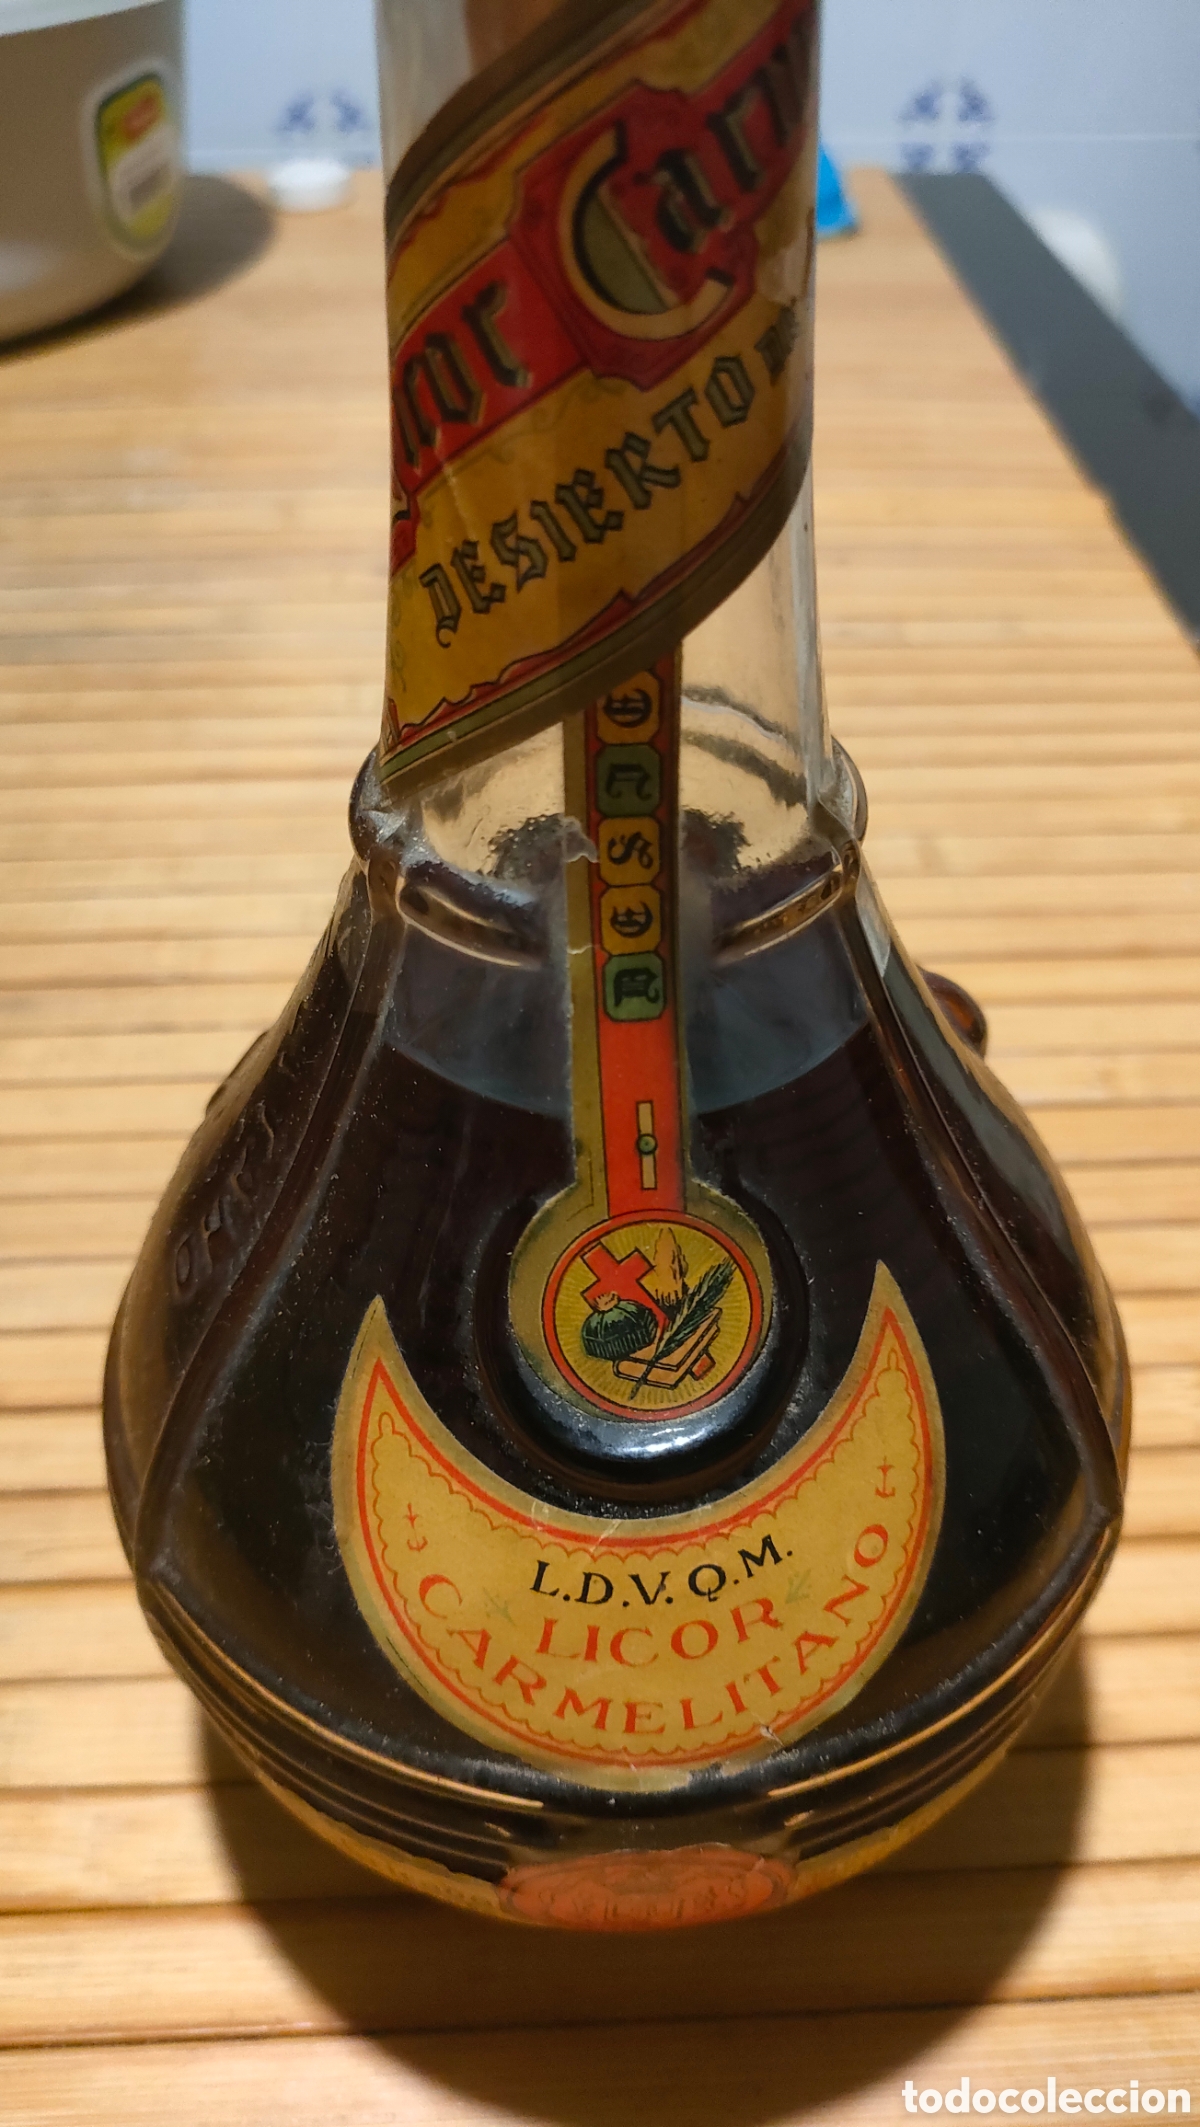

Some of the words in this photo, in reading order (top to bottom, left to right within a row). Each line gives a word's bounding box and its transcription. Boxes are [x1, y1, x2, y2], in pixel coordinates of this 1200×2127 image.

[419, 354, 756, 649] DESIERTO
[417, 1523, 890, 1736] CARMELITANO
[535, 1597, 785, 1667] LICOR
